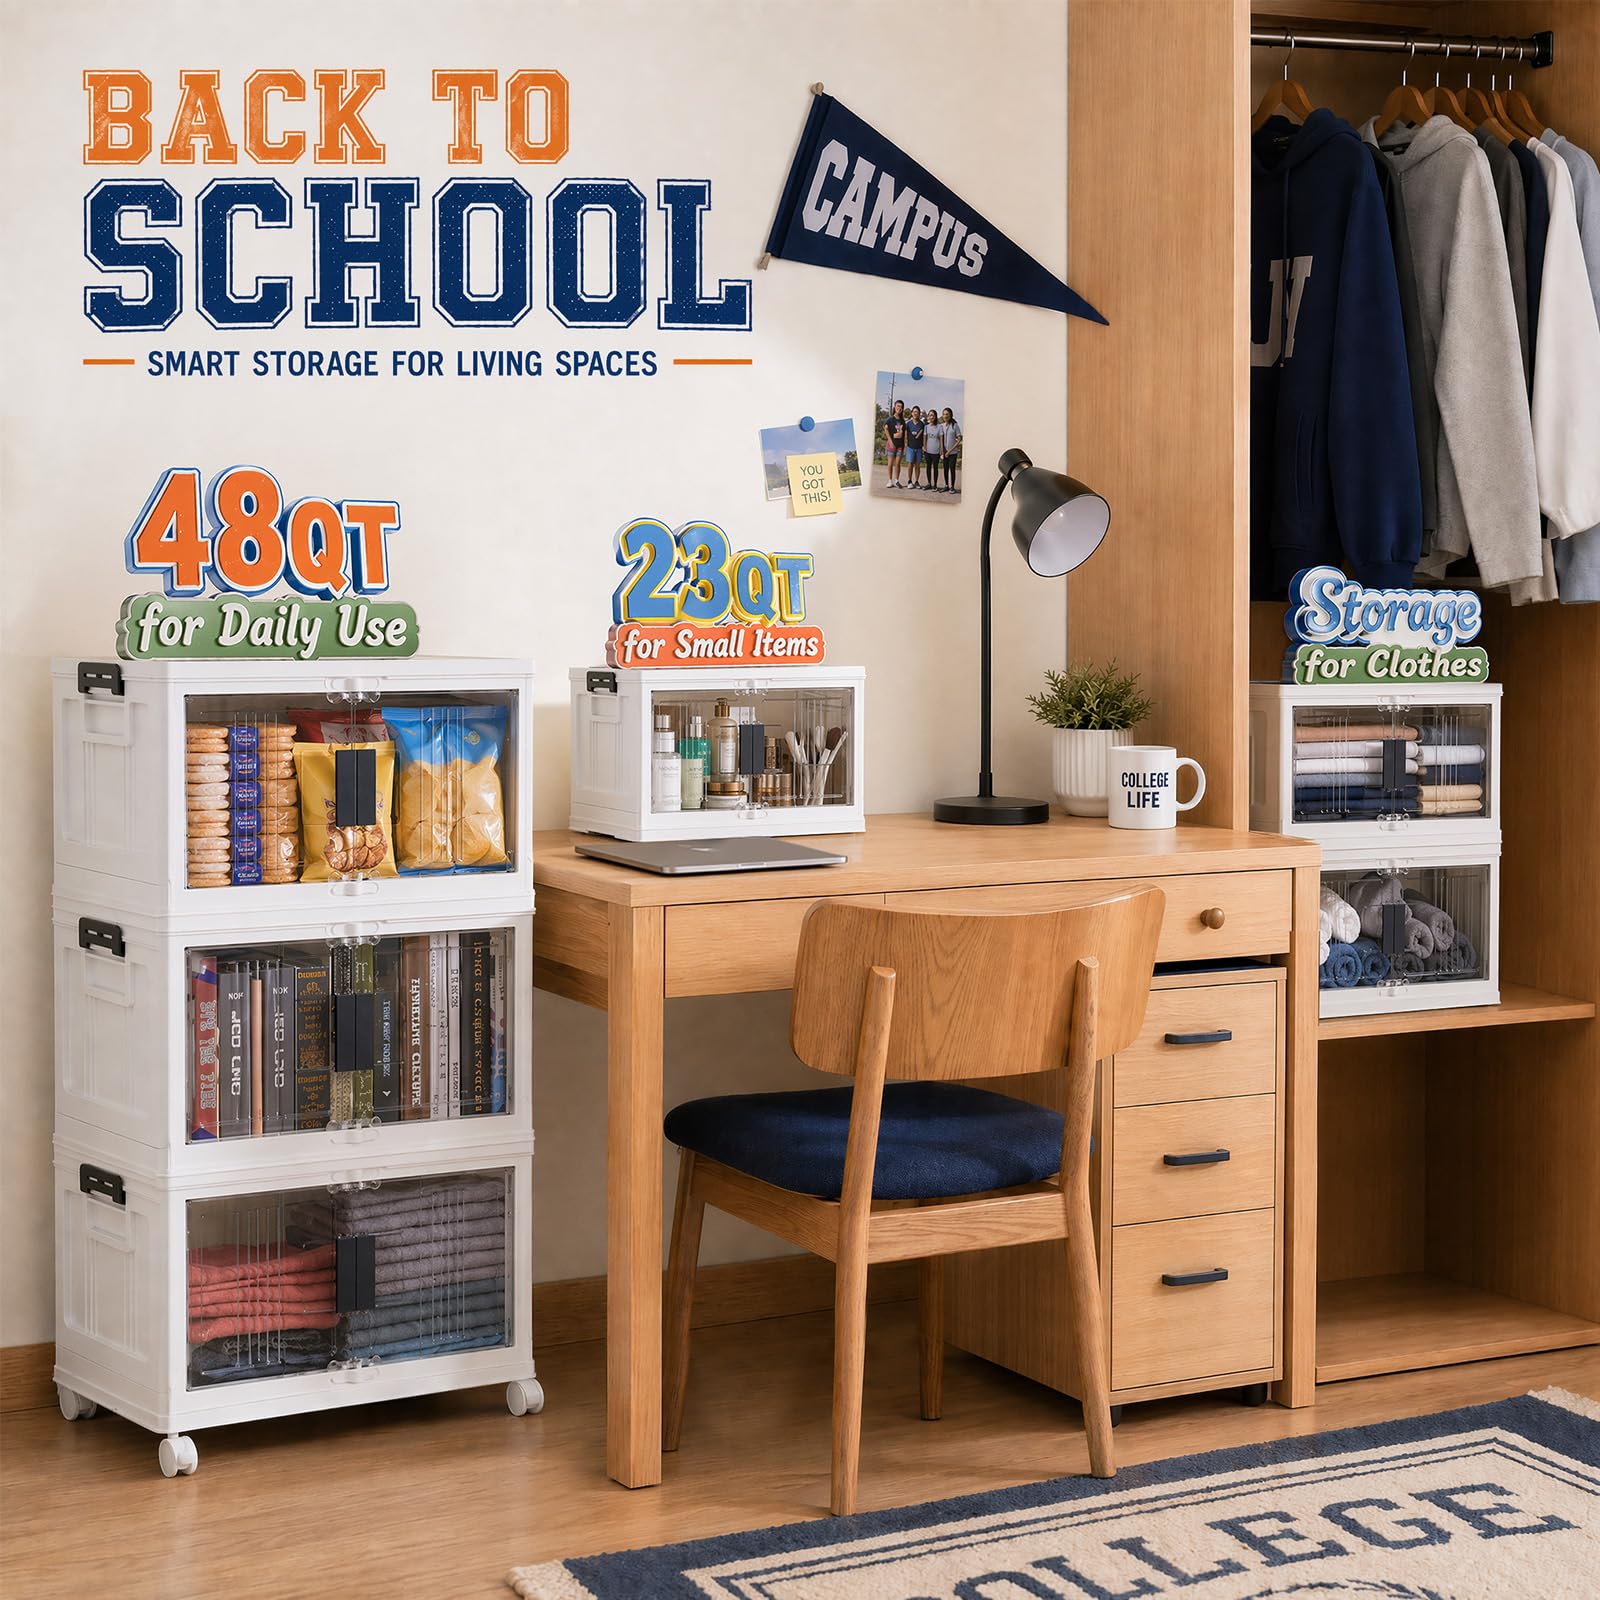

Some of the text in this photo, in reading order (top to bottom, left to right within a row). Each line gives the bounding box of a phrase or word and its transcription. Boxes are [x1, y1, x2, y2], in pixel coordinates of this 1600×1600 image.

[802, 138, 989, 278] CAMPUS
[800, 465, 823, 476] YOU
[802, 478, 825, 490] GOT
[801, 490, 832, 504] THIS!
[124, 464, 402, 600] 48QT
[612, 517, 815, 627] 23QT
[1297, 569, 1481, 649] Storage
[139, 601, 408, 658] for Daily Use
[624, 629, 819, 663] for Small Items
[1305, 649, 1482, 683] for Clothes
[1121, 772, 1169, 788] COLLEGE
[1127, 791, 1160, 808] LIFE
[904, 1481, 1582, 1600] OLLEGE
